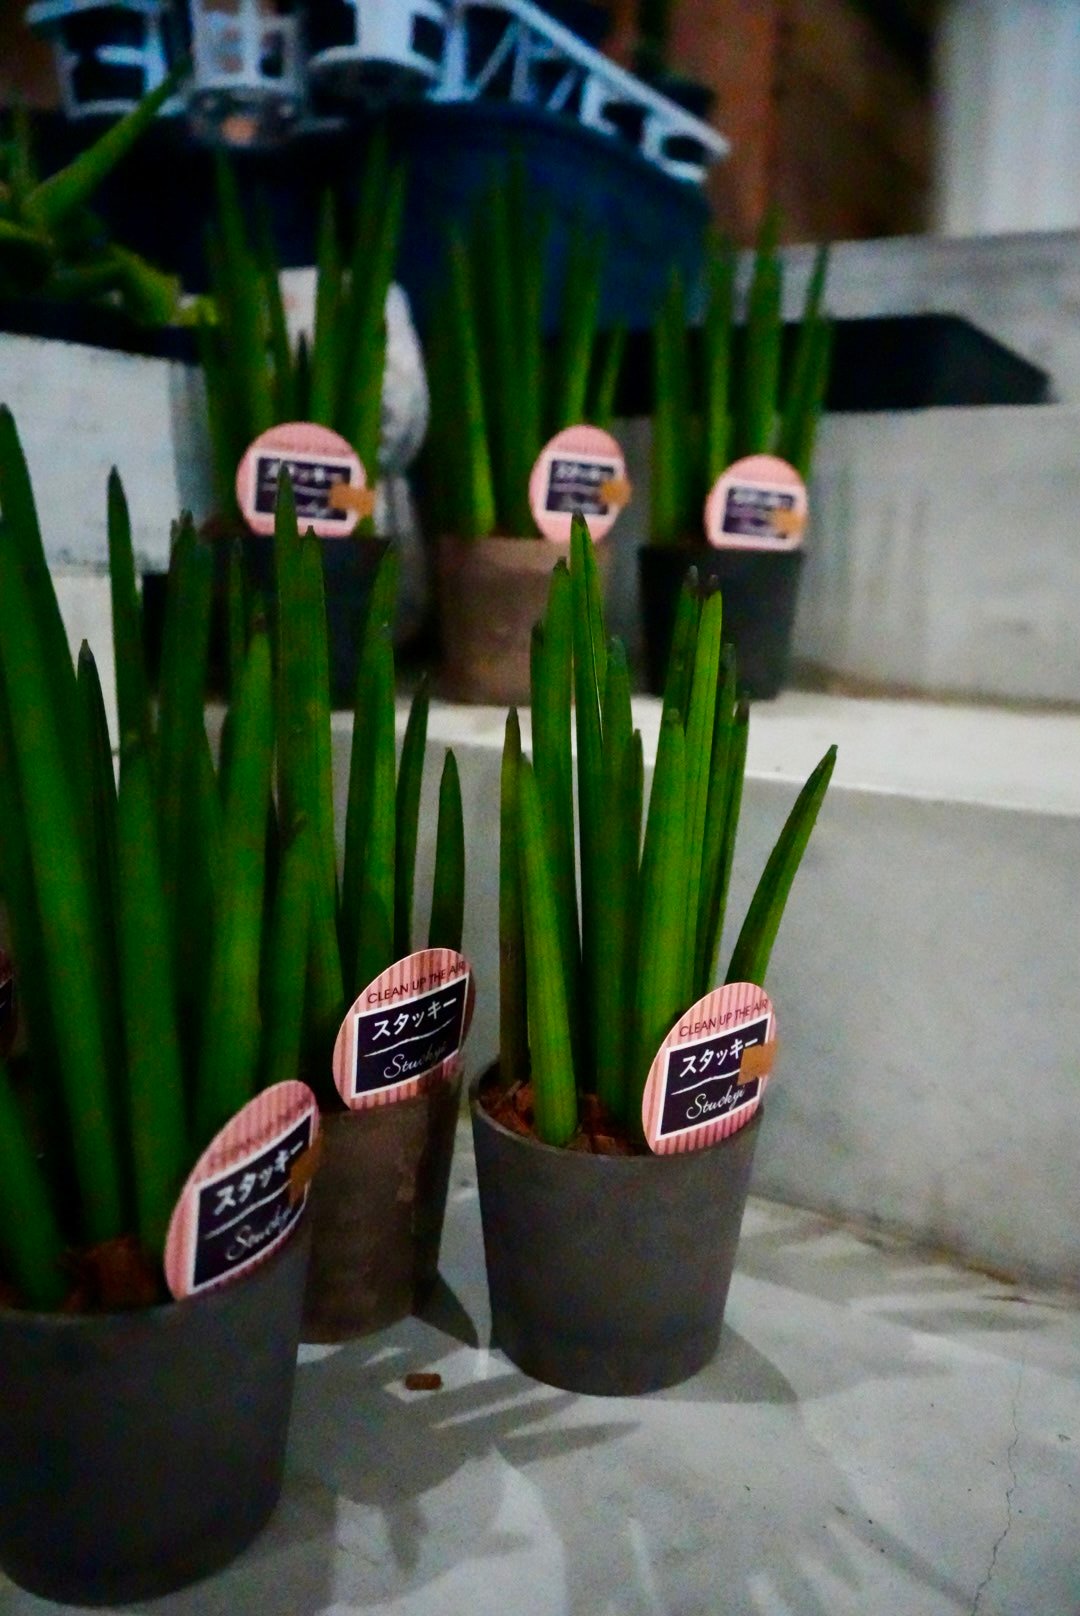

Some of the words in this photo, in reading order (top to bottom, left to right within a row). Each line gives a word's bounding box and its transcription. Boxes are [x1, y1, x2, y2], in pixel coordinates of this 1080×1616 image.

[367, 985, 409, 1004] CLEAN
[412, 978, 427, 991] UP
[429, 970, 447, 985] THE
[371, 997, 457, 1041] スタッキー
[679, 1018, 717, 1038] CLEAN
[719, 1012, 733, 1026] UP
[734, 1007, 751, 1021] THE
[750, 998, 768, 1014] AIR
[679, 1037, 759, 1078] スタッキー
